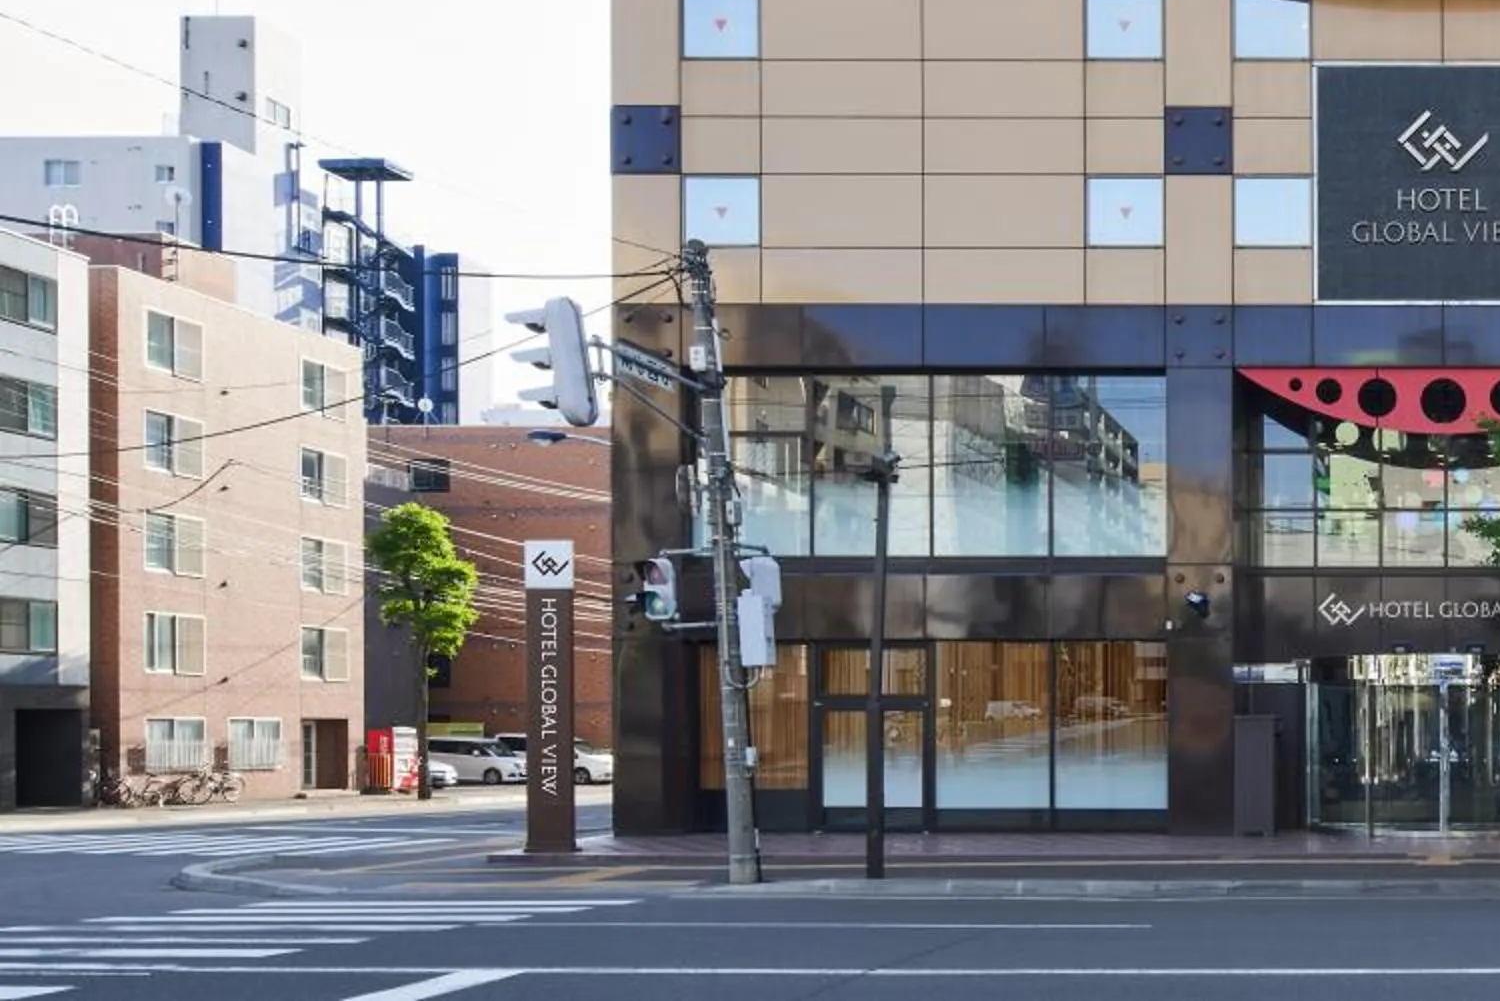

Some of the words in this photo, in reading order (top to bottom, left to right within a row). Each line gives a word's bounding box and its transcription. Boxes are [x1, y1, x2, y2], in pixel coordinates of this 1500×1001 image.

[1396, 187, 1489, 212] HOTEL
[1350, 220, 1457, 243] GLOBAL
[1368, 600, 1435, 619] HOTEL
[541, 598, 558, 662] HOTEL
[541, 664, 558, 740] GLOBAL
[541, 744, 558, 796] VIEW
